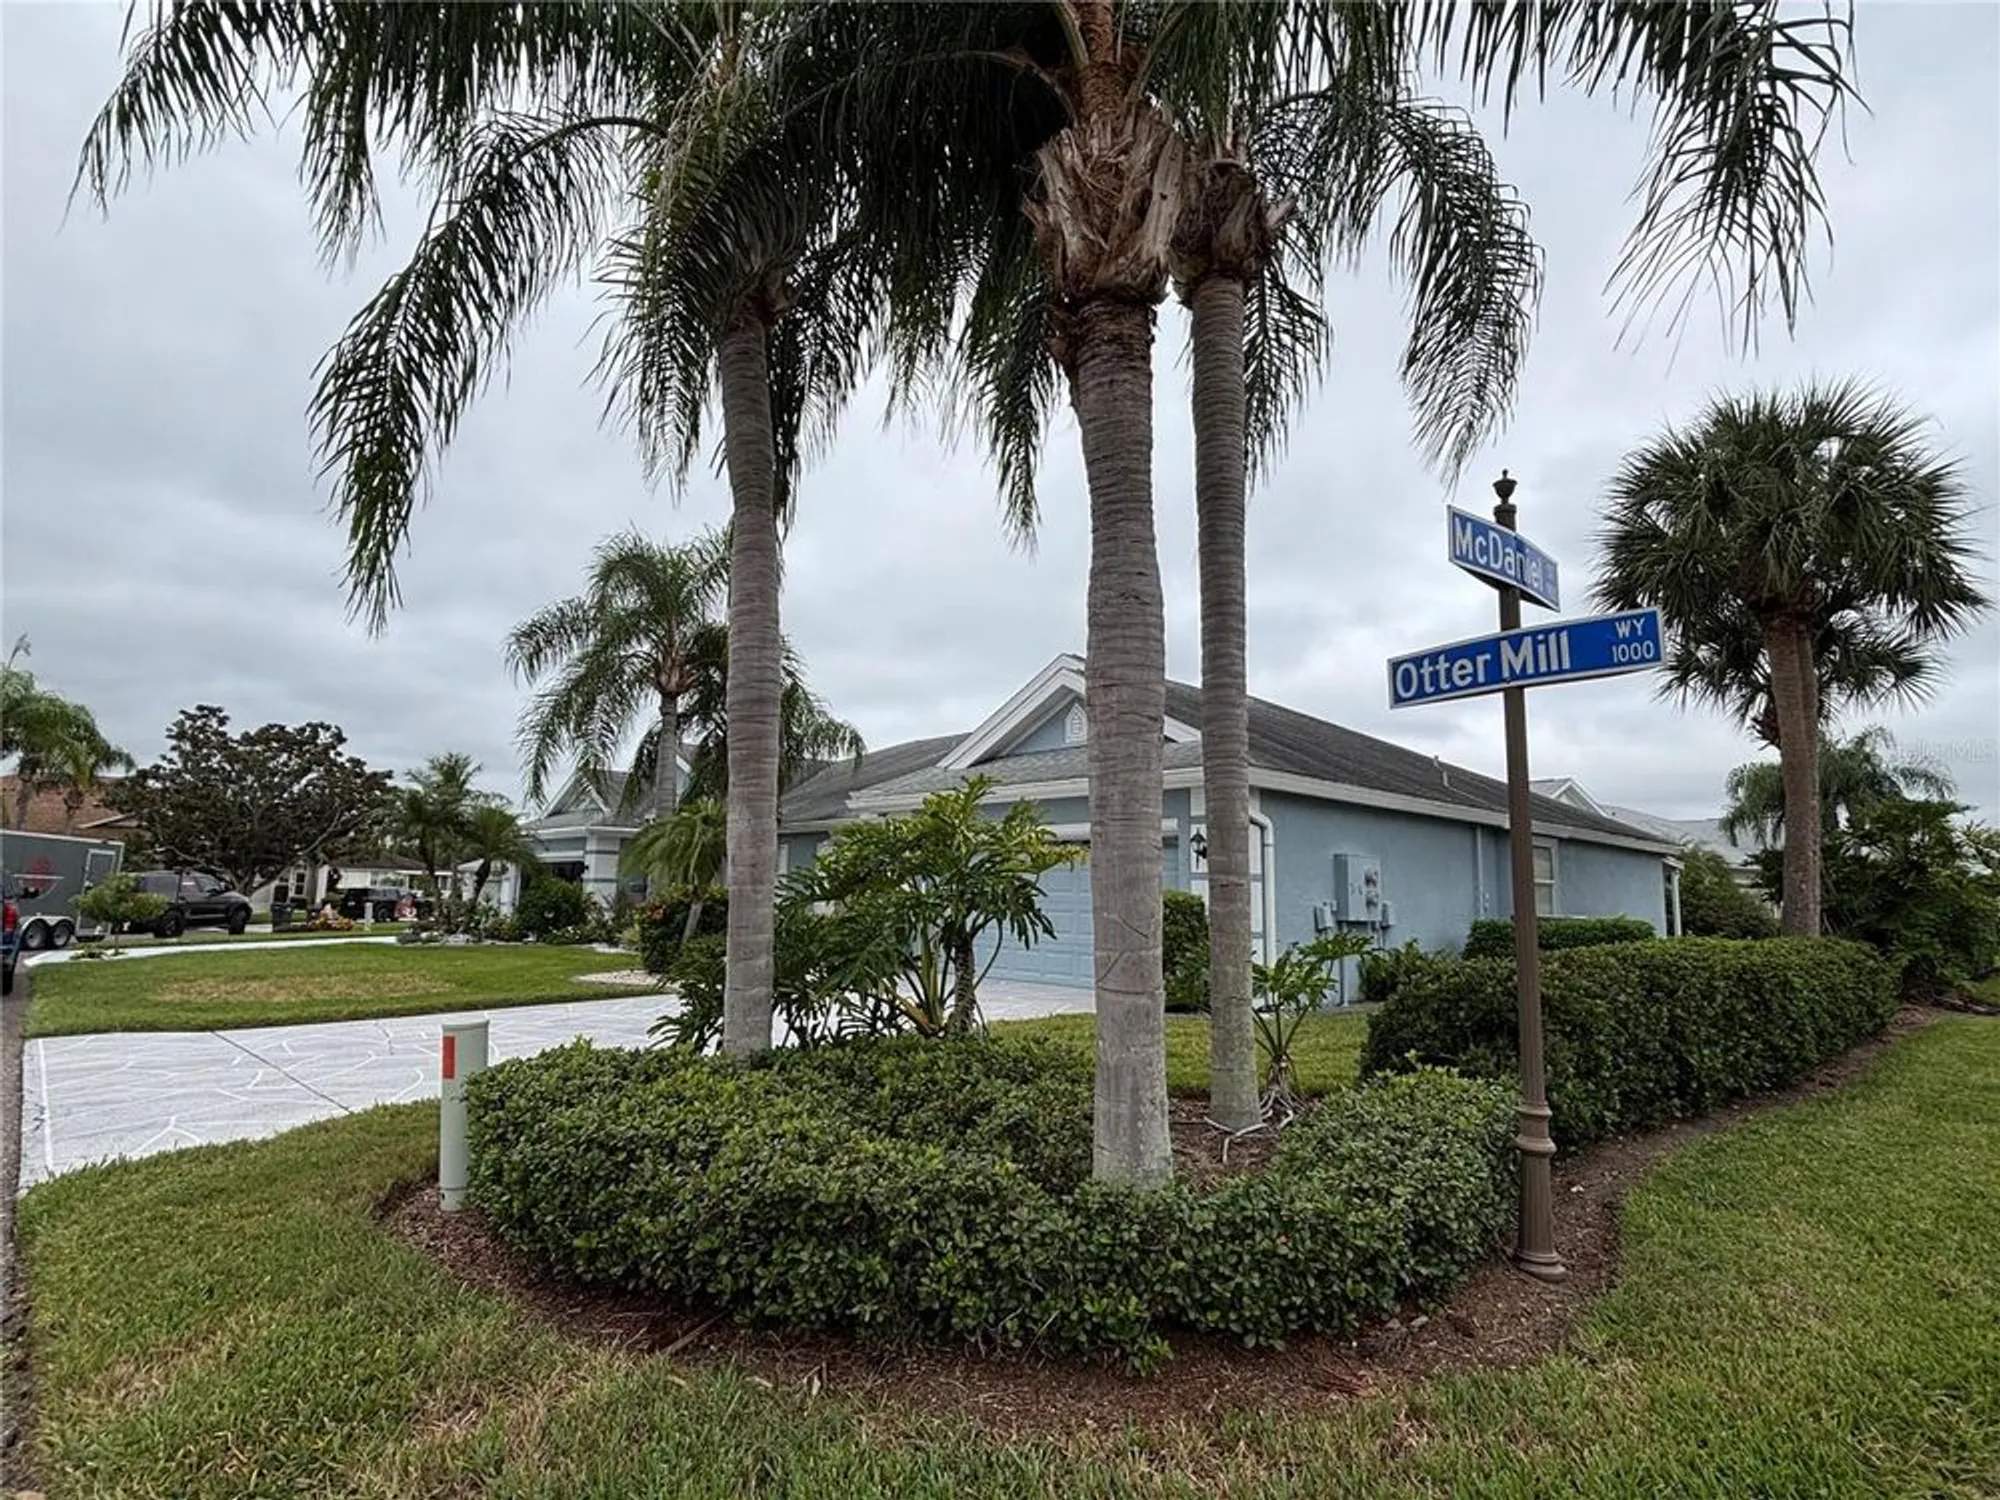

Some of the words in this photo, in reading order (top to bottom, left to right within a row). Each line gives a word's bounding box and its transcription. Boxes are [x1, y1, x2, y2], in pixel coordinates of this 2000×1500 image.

[1454, 517, 1543, 593] McDaniel
[1615, 617, 1645, 639] WY
[1396, 653, 1491, 698] Otter
[1500, 630, 1571, 679] Mill
[1612, 640, 1654, 663] 1000
